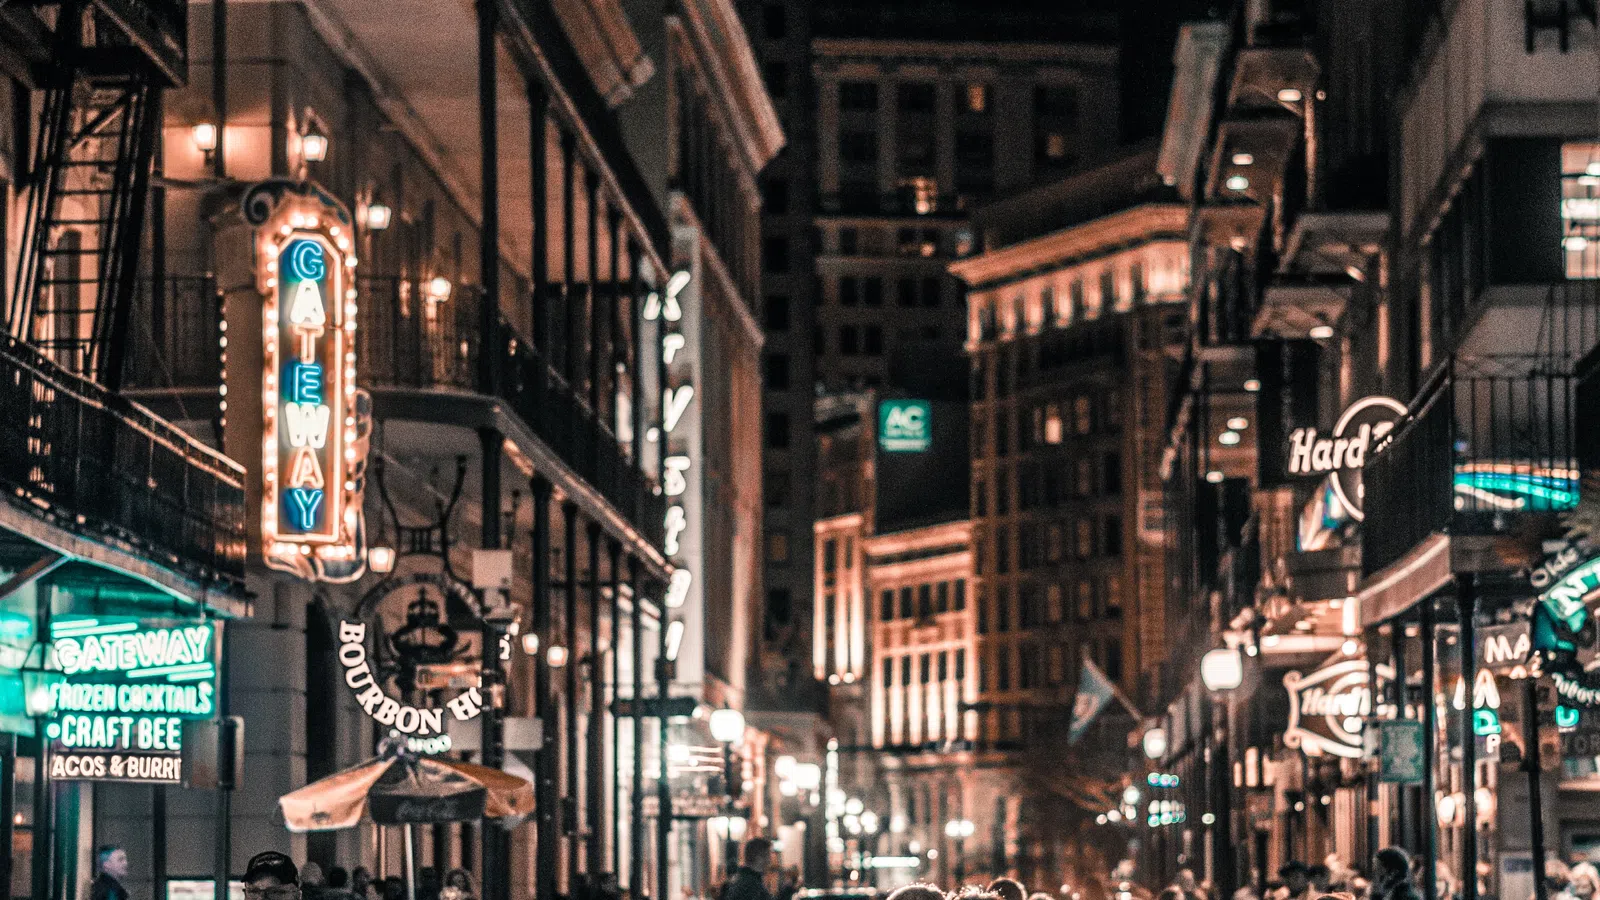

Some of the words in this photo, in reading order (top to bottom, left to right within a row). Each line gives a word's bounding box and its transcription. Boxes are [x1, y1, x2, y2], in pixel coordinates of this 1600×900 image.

[285, 239, 331, 531] GATEWAY
[885, 406, 925, 434] AC
[1287, 423, 1371, 474] Hard
[53, 626, 210, 674] GATEWAY
[50, 682, 117, 712] FROZEN
[117, 682, 213, 714] COCKTAILS
[338, 619, 444, 735] BOURBON
[61, 714, 134, 750] CRAFT
[137, 717, 181, 750] BEE
[109, 755, 128, 777] &
[127, 756, 182, 780] BURRI
